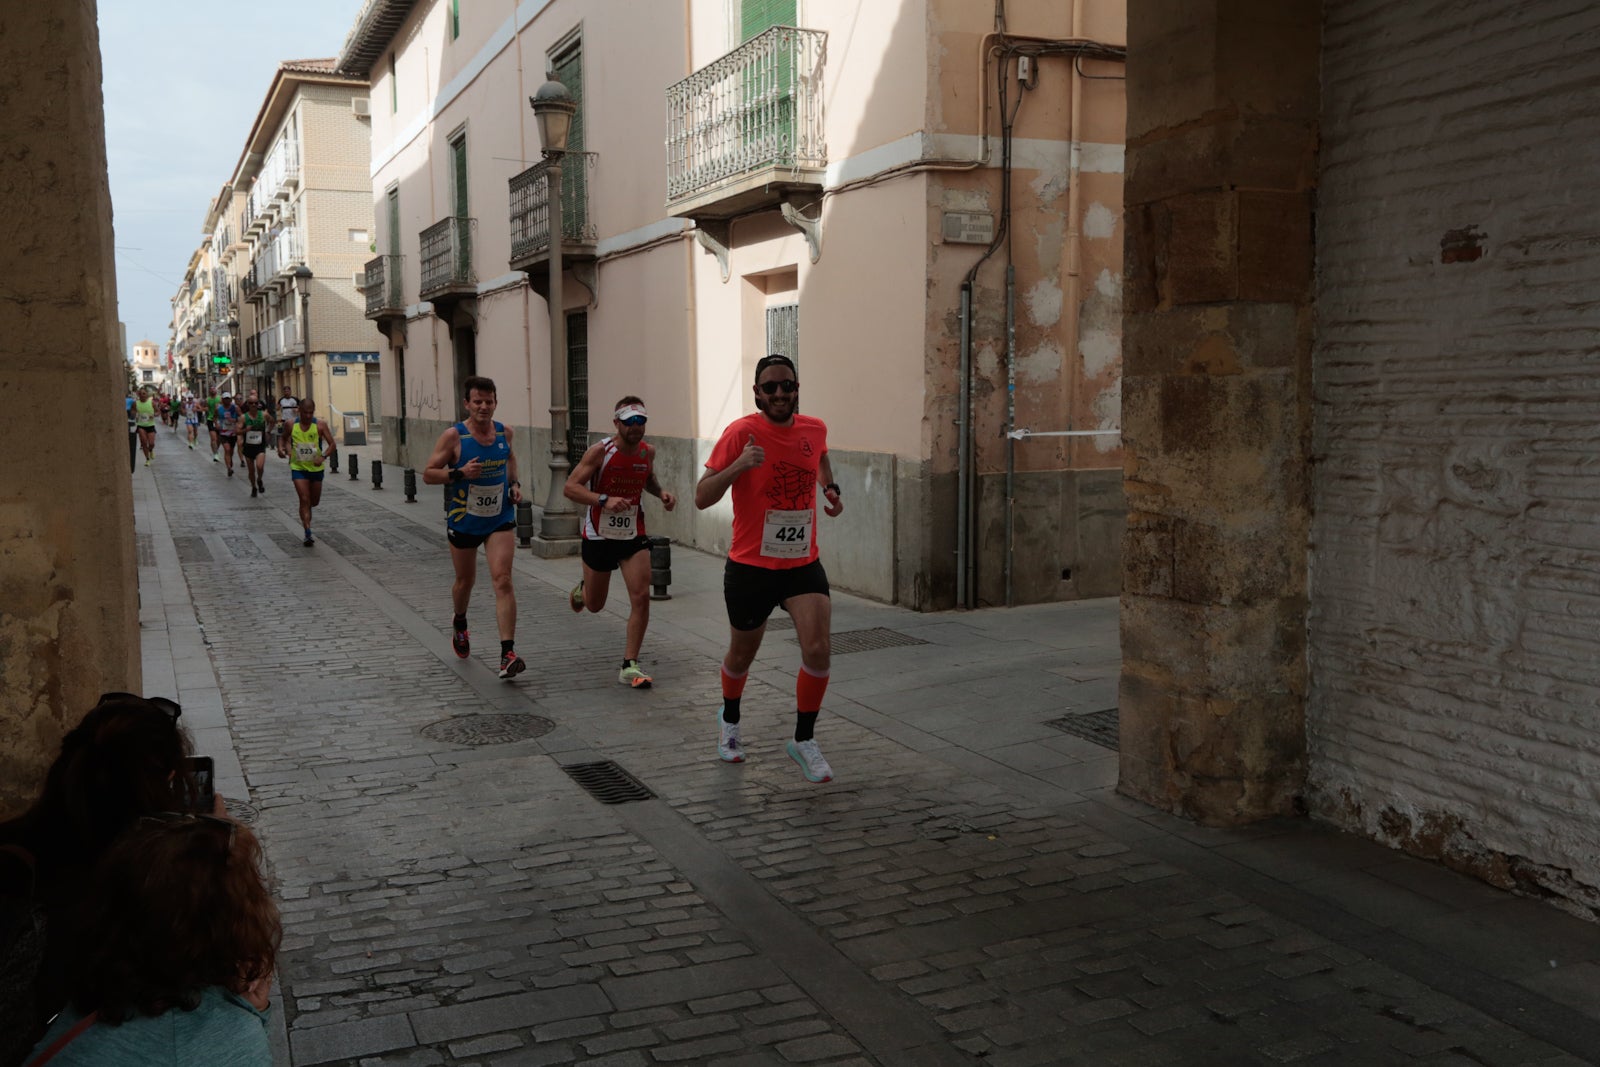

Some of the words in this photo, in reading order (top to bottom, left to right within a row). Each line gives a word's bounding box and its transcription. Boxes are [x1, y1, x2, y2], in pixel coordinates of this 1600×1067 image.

[476, 495, 498, 506] 304
[608, 516, 631, 528] 390
[775, 526, 805, 542] 424
